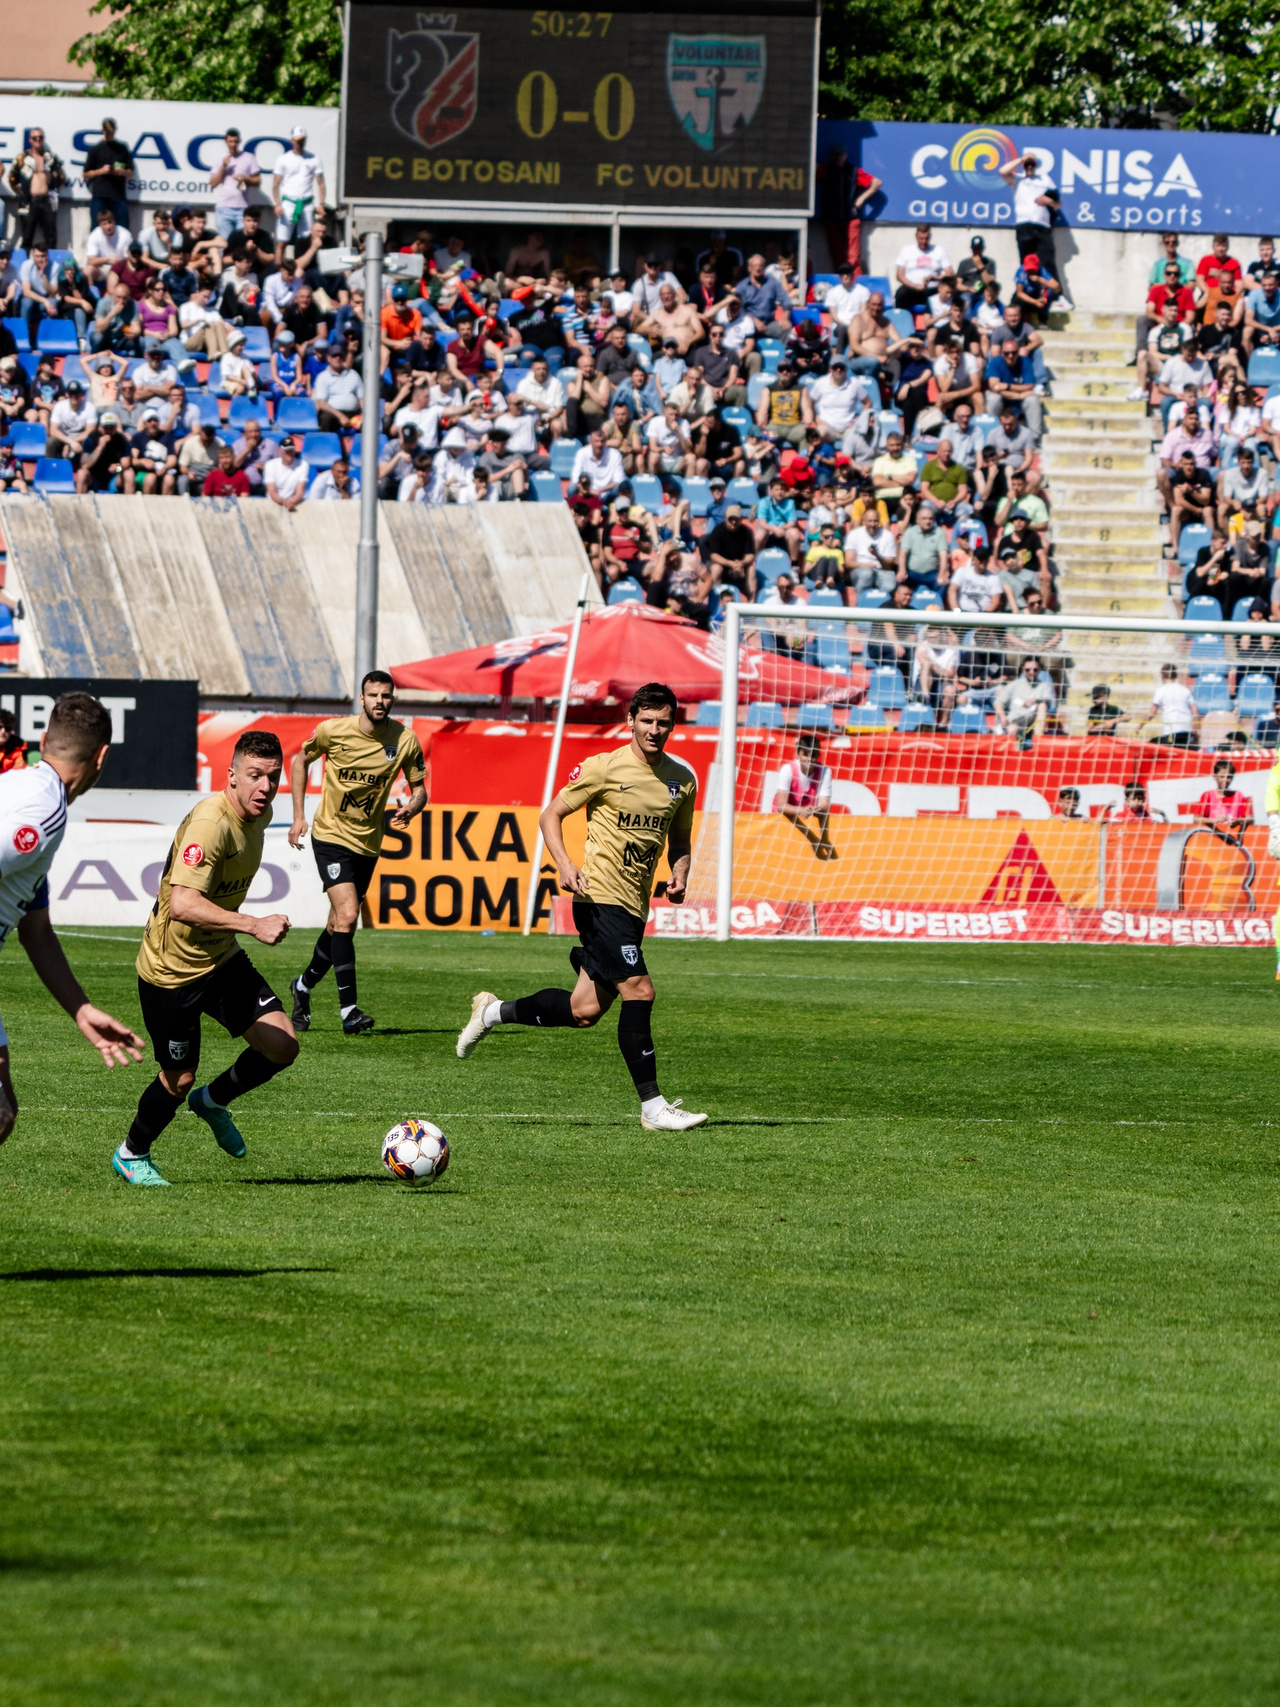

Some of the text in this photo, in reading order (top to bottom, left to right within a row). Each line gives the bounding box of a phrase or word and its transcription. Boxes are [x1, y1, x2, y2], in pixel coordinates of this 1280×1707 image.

[531, 11, 612, 37] 50:27
[517, 70, 635, 141] 0-0
[367, 157, 560, 185] FC BOTOSANI
[597, 165, 803, 190] FC VOLUNTARI
[909, 198, 1203, 228] aquap & sports
[1083, 383, 1109, 397] 12
[1100, 528, 1110, 542] 8
[1110, 600, 1121, 613] 6
[337, 768, 390, 788] MAXBET
[380, 809, 528, 863] SIKA
[379, 864, 561, 928] ROMÂ
[859, 906, 1028, 937] SUPERBET
